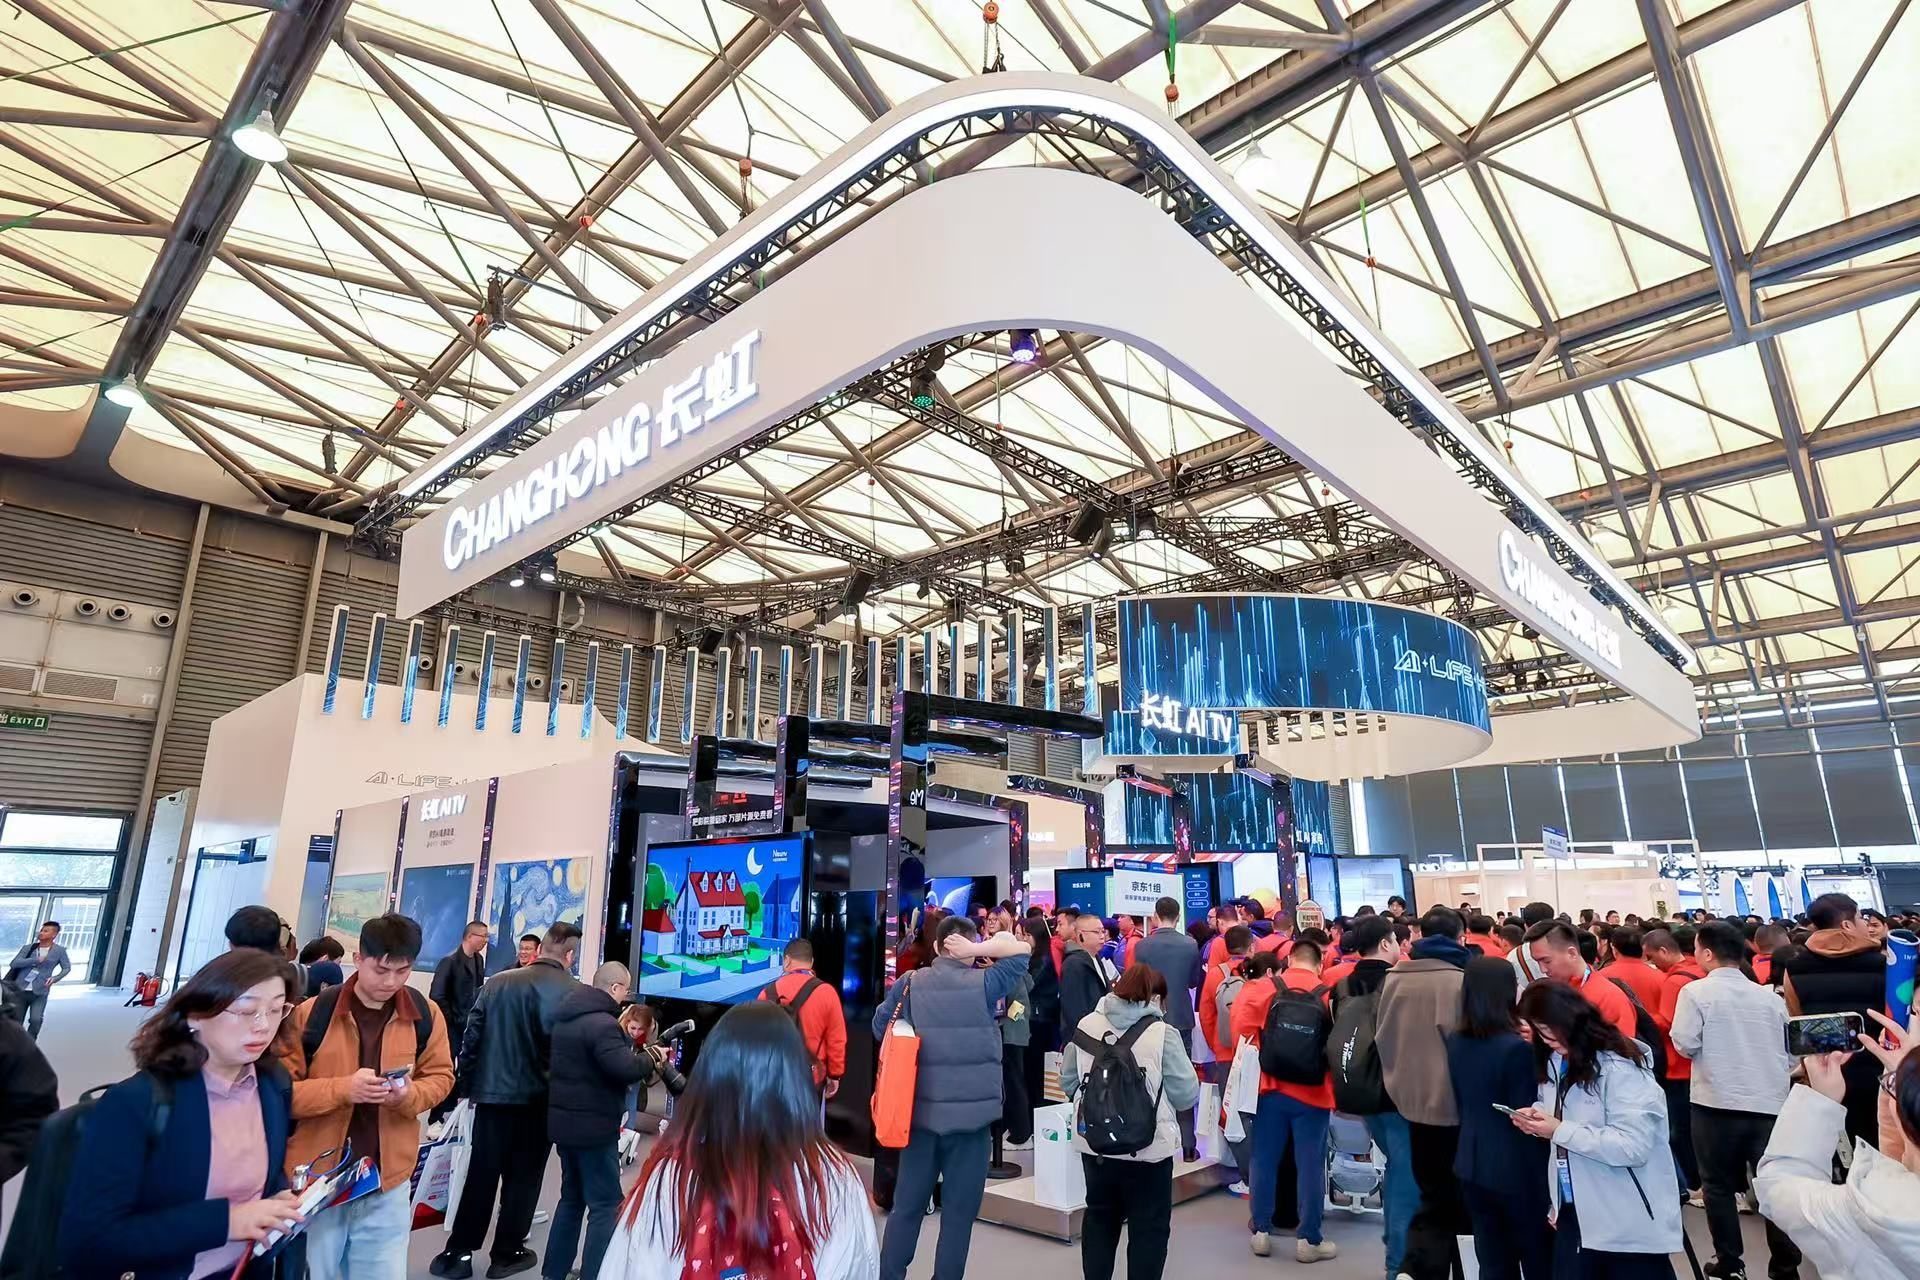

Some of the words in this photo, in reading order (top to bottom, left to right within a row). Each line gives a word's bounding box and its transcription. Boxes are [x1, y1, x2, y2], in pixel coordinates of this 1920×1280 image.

[443, 402, 652, 570] CHANGHONG
[656, 328, 763, 448] 长虹
[1429, 654, 1474, 688] LIFE
[10, 716, 33, 725] EXIT
[1140, 689, 1182, 734] 长虹
[1186, 706, 1206, 738] AI
[1209, 711, 1232, 743] TV
[1131, 881, 1162, 893] 京东1组
